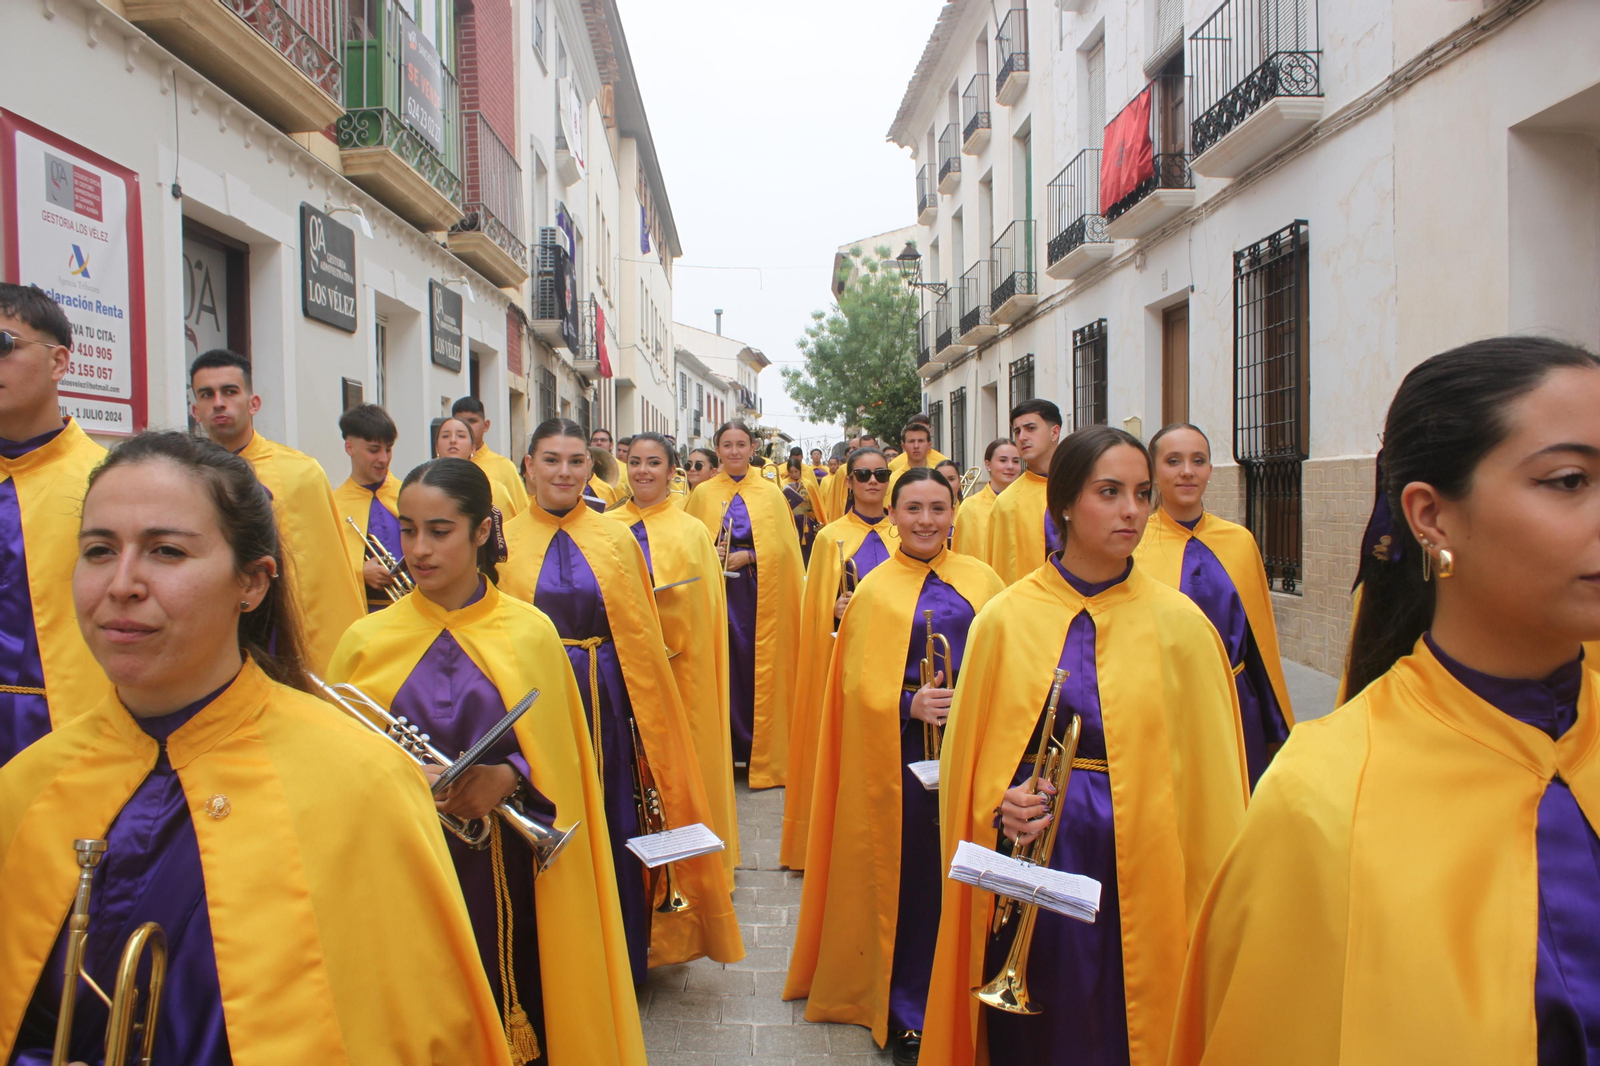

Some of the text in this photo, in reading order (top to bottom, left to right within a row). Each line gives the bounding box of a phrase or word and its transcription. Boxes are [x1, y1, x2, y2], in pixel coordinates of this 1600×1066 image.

[408, 62, 419, 87] SE
[408, 96, 419, 122] 624
[420, 108, 427, 130] 23
[75, 223, 88, 236] LOS
[309, 280, 355, 318] LOS VÉLEZ
[96, 300, 123, 319] Renta
[85, 326, 94, 338] TU
[96, 329, 115, 343] CITA:
[77, 343, 93, 357] 410
[96, 346, 112, 360] 905
[435, 336, 444, 355] LOS
[78, 364, 94, 377] 155
[97, 366, 113, 380] 057
[76, 408, 80, 418] 1
[82, 408, 103, 420] JULIO
[105, 411, 122, 422] 2024
